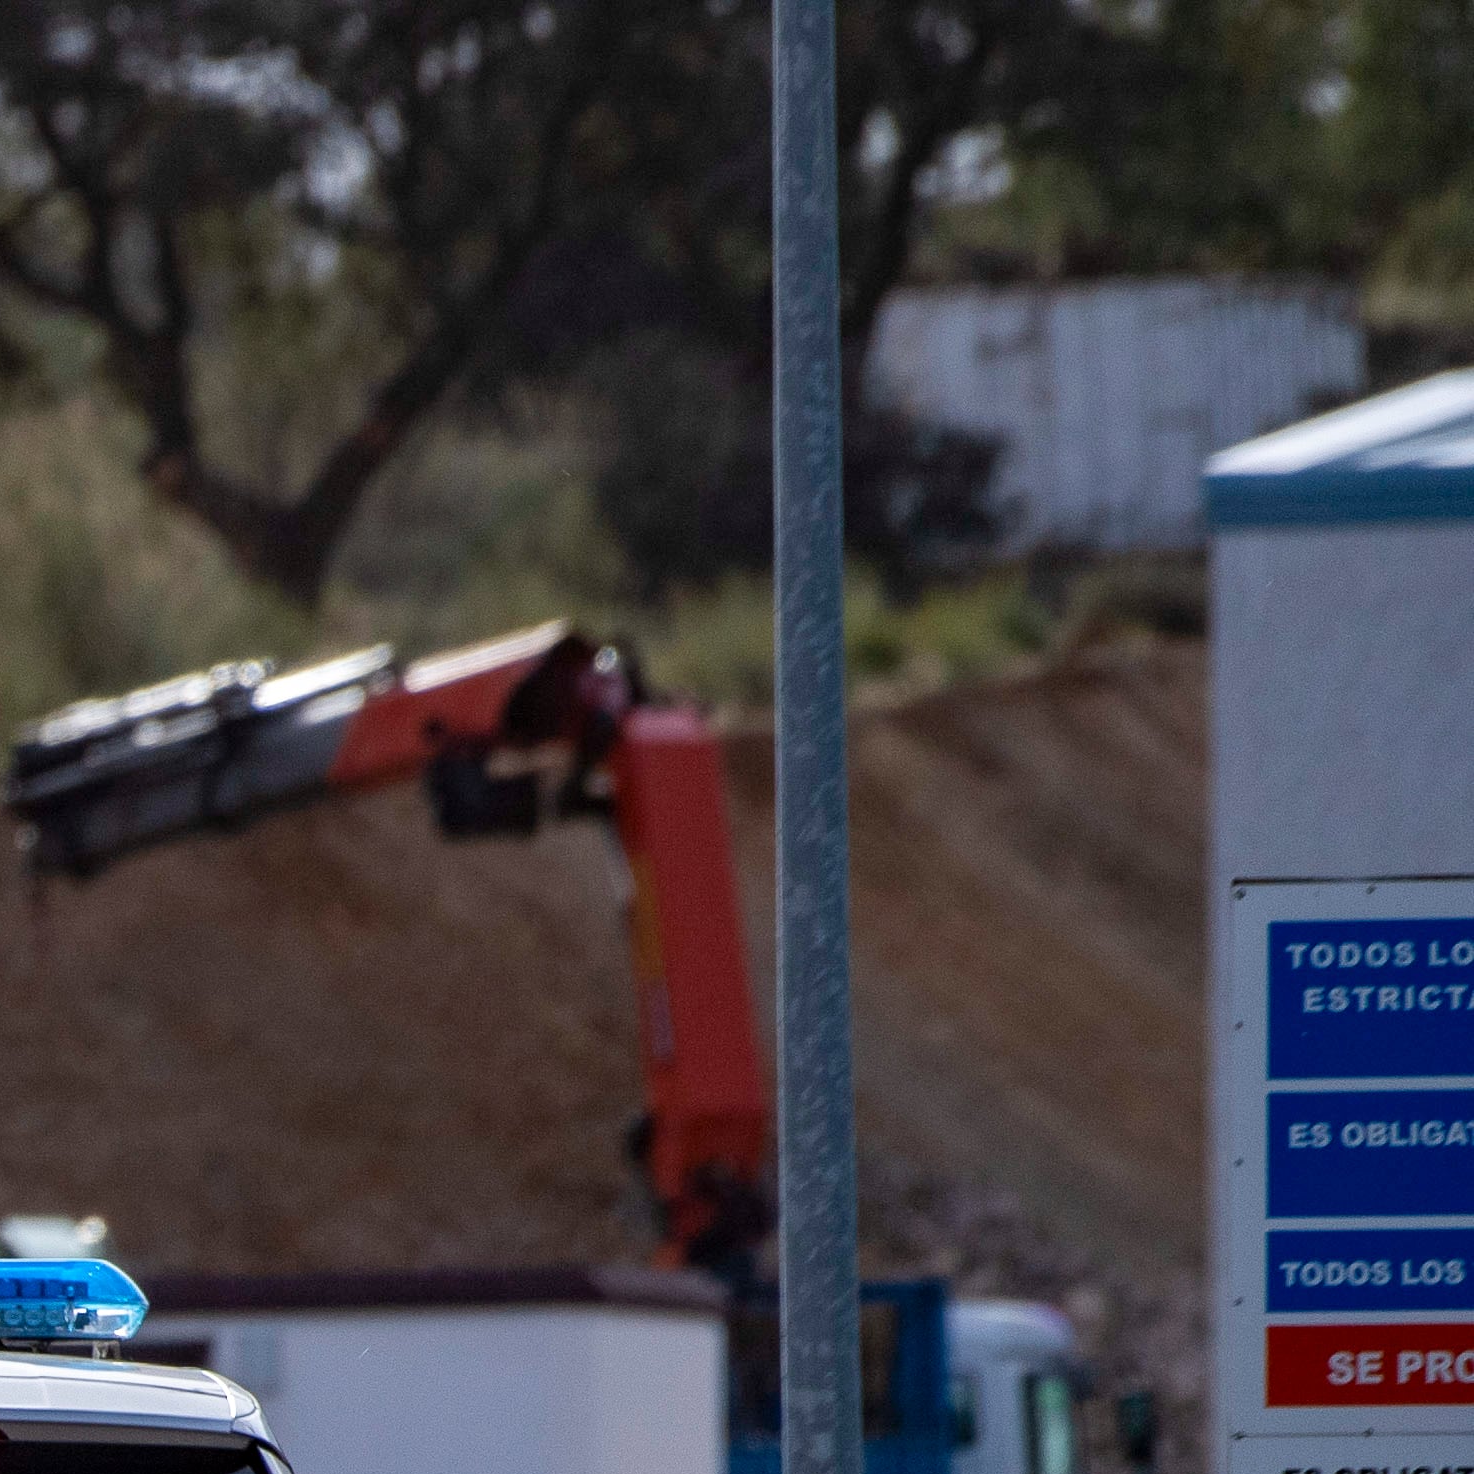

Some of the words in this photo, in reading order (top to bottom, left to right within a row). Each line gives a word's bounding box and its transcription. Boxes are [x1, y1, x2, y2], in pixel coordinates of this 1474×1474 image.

[1285, 940, 1416, 969] TODOS
[1427, 939, 1474, 967] LO
[1302, 984, 1474, 1013] ESTRICT
[1288, 1121, 1332, 1149] ES
[1278, 1259, 1393, 1288] TODOS
[1401, 1258, 1466, 1287] LOS
[1327, 1351, 1385, 1385] SE
[1396, 1350, 1474, 1384] PRO
